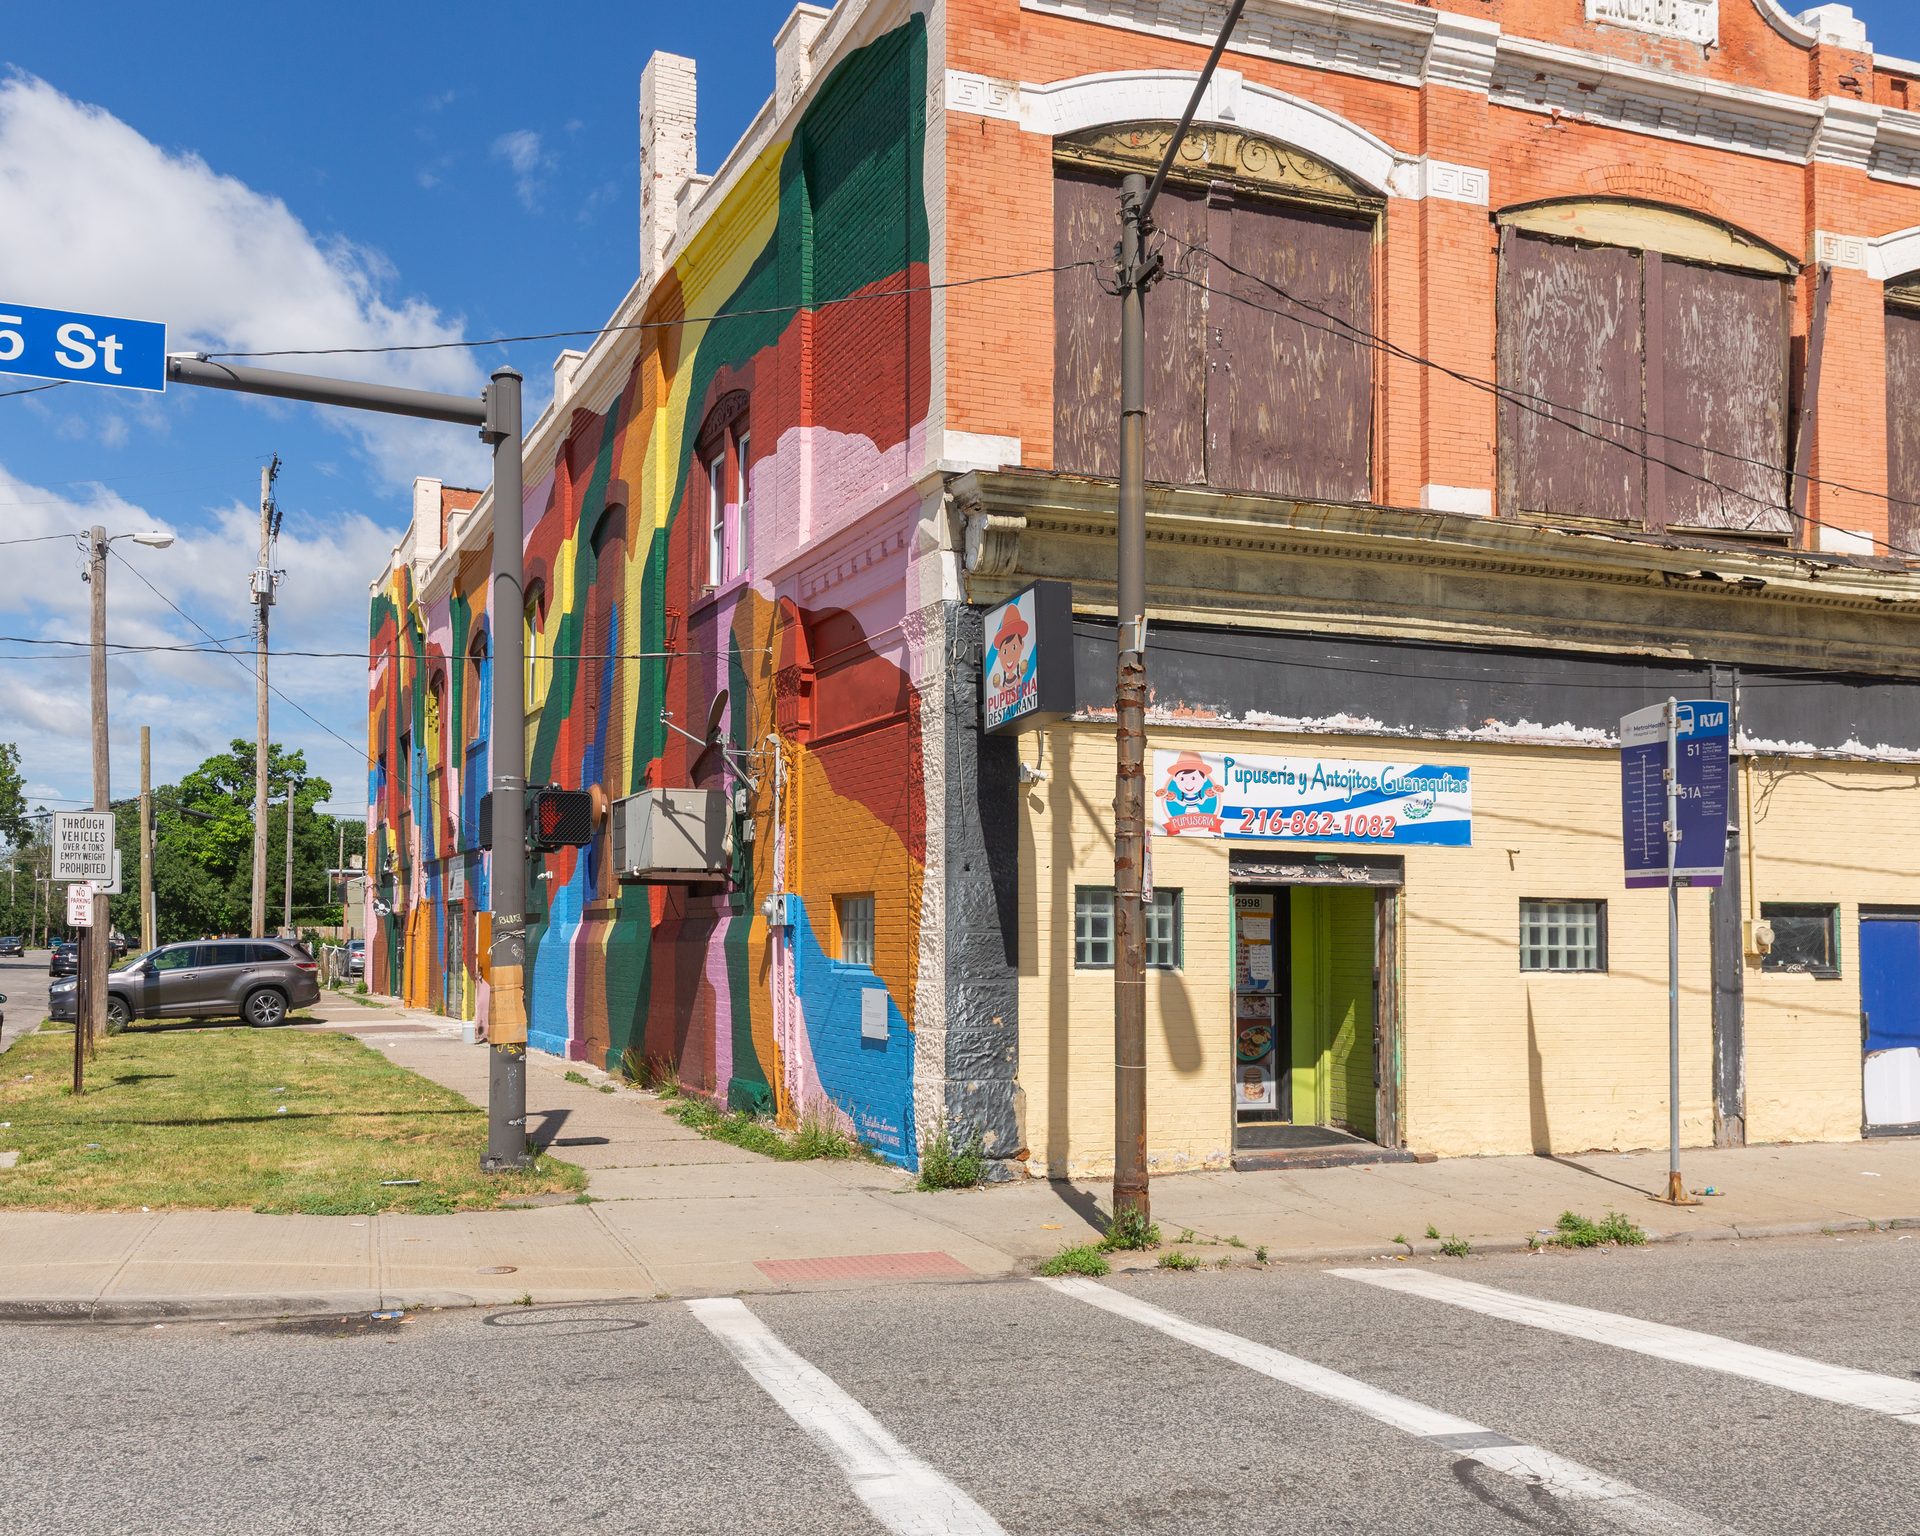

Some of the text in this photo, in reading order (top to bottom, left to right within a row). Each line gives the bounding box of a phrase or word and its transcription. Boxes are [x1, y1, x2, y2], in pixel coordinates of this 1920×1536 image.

[0, 314, 123, 375] 5 St
[988, 677, 1037, 713] PUPUSERIA
[988, 694, 1038, 726] RESTAURANT
[1699, 712, 1724, 728] RTA
[1687, 743, 1700, 757] 51
[1297, 772, 1308, 795] y
[1310, 762, 1378, 803] Antojitos
[1381, 766, 1469, 802] Guanaquitas
[1680, 787, 1702, 800] 51A
[62, 818, 105, 830] THROUGH
[1172, 815, 1215, 829] PUPUSERIA
[1239, 809, 1398, 839] 216-862-1082
[62, 831, 105, 843] VEHICLES
[62, 843, 105, 852] OVER 4 TONS
[60, 852, 106, 861] EMPTY WEIGHT
[60, 862, 106, 874] PROHIBITED
[76, 889, 86, 898] NO
[71, 897, 91, 905] PARKING
[1235, 898, 1260, 908] 2998
[75, 910, 86, 918] TIME
